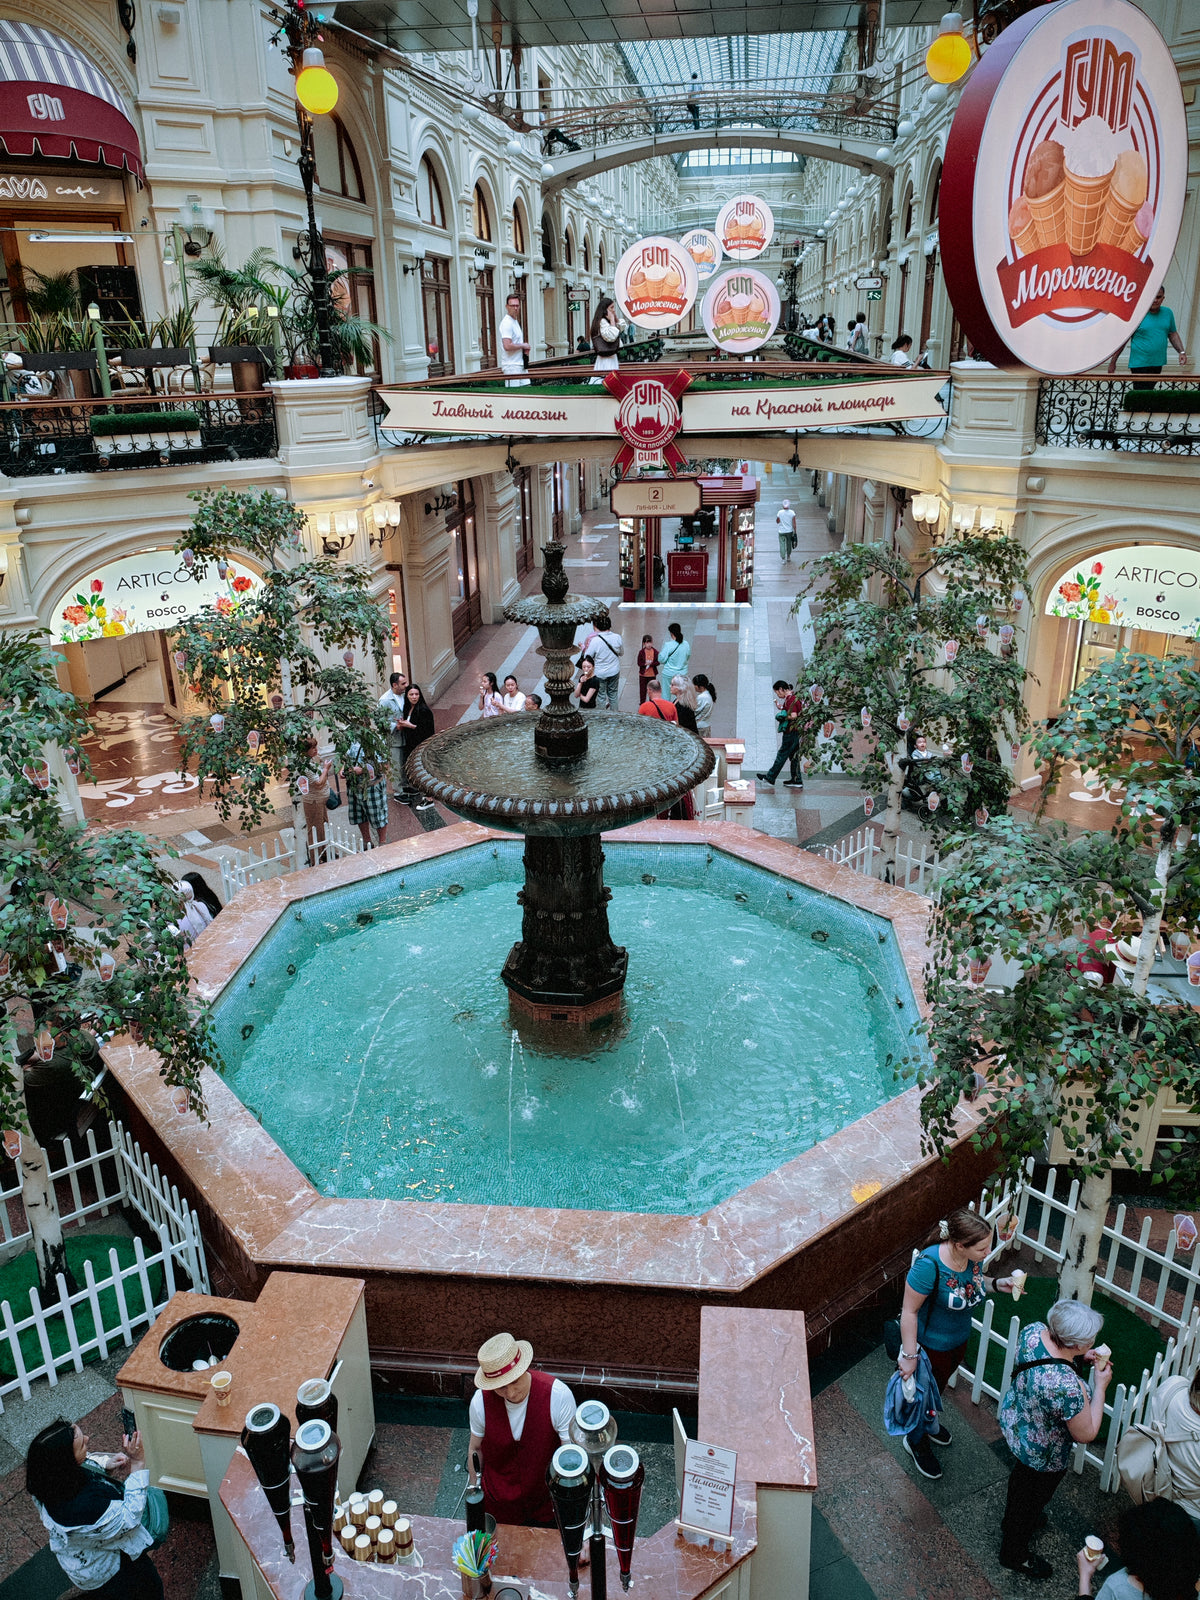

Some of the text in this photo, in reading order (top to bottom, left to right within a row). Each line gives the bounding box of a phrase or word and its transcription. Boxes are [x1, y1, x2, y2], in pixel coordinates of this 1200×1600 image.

[1011, 263, 1138, 310] Мороженое
[630, 301, 682, 313] Мороженое
[718, 327, 766, 339] Мороженое
[432, 400, 568, 421] Главный магазин
[731, 395, 895, 420] на Красной площади
[622, 429, 674, 449] КРАСНАЯ ПЛОЩАДЬ
[638, 451, 659, 462] GUM
[652, 489, 660, 500] 2
[1114, 565, 1200, 588] ARTICO
[146, 605, 187, 618] BOSCO
[1136, 606, 1181, 621] BOSCO
[688, 1473, 730, 1493] Лимонад
